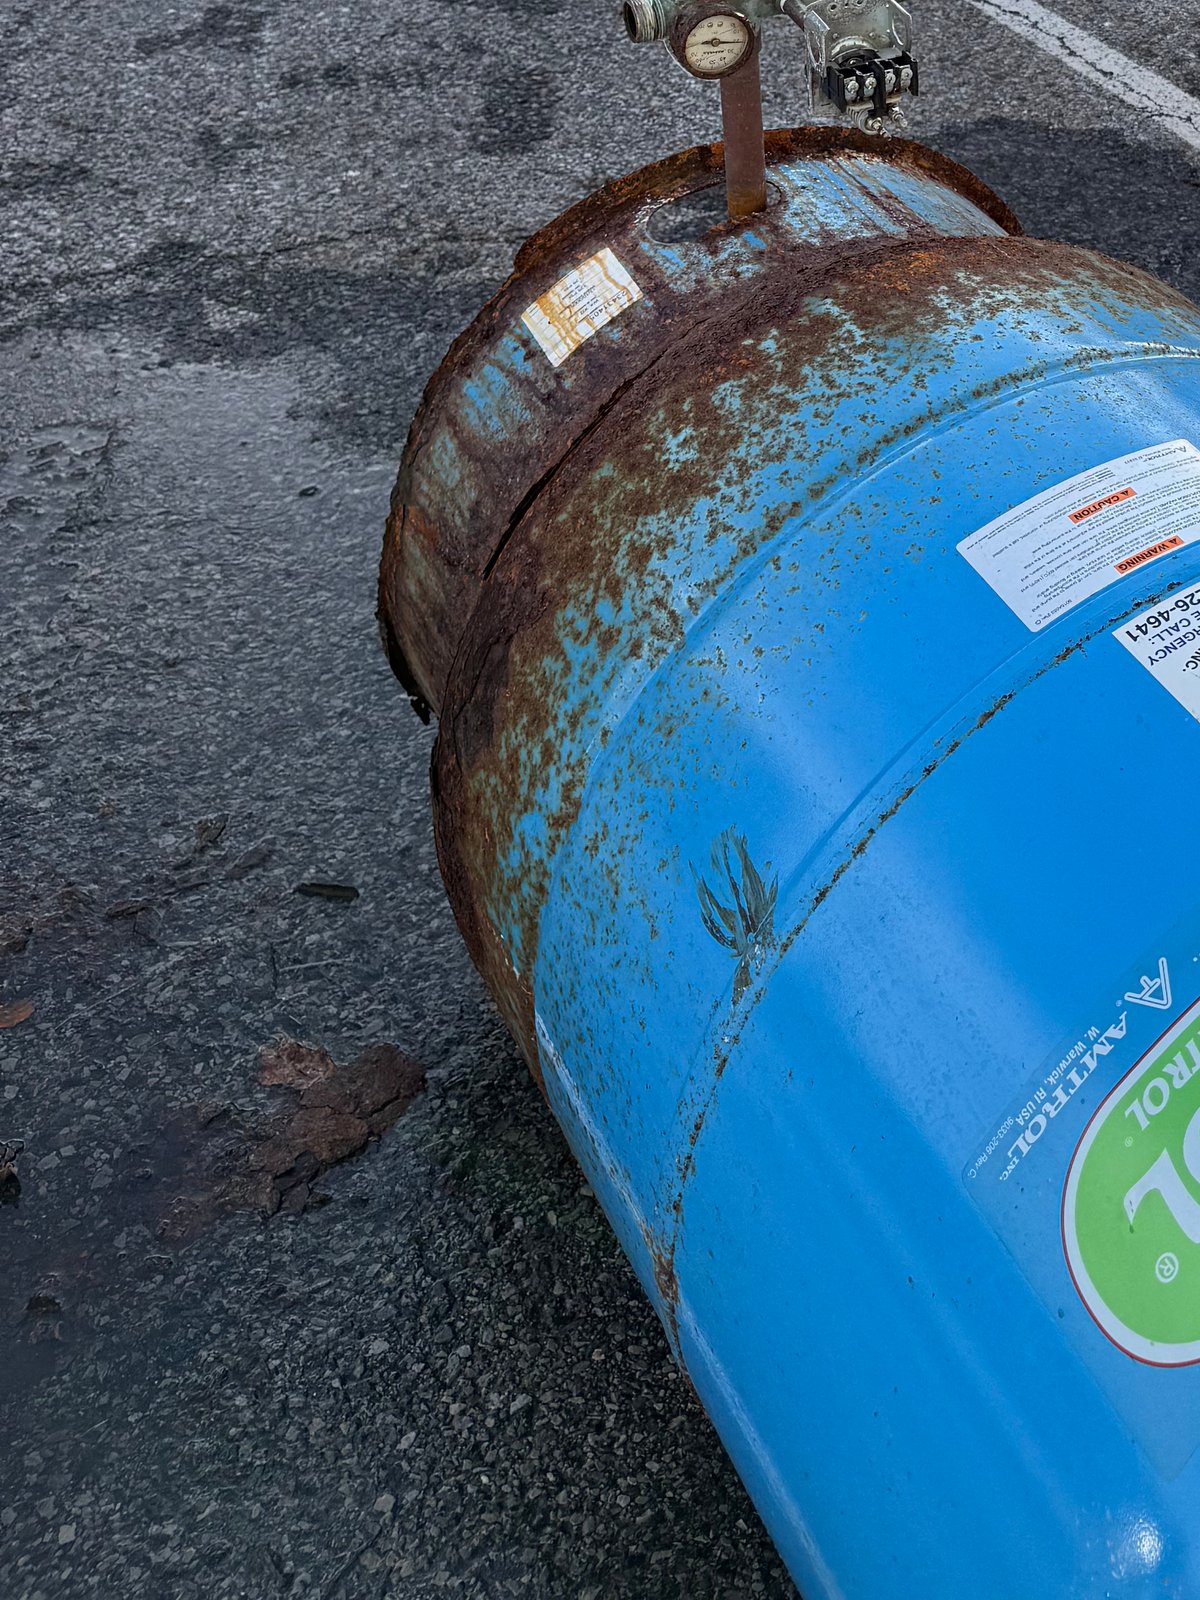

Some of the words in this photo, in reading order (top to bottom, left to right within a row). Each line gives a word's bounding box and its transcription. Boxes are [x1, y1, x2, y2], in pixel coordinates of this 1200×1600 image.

[1074, 495, 1120, 521] CAUTION
[1118, 542, 1170, 571] WARNING
[1148, 617, 1191, 645] CALL:
[1084, 1026, 1100, 1041] W.
[1044, 1041, 1087, 1085] Warwick,
[1007, 1011, 1128, 1158] AMTROL
[1034, 1088, 1046, 1105] RI
[1016, 1101, 1037, 1126] USA
[986, 1116, 1014, 1155] 9033-206
[976, 1154, 988, 1169] Rev
